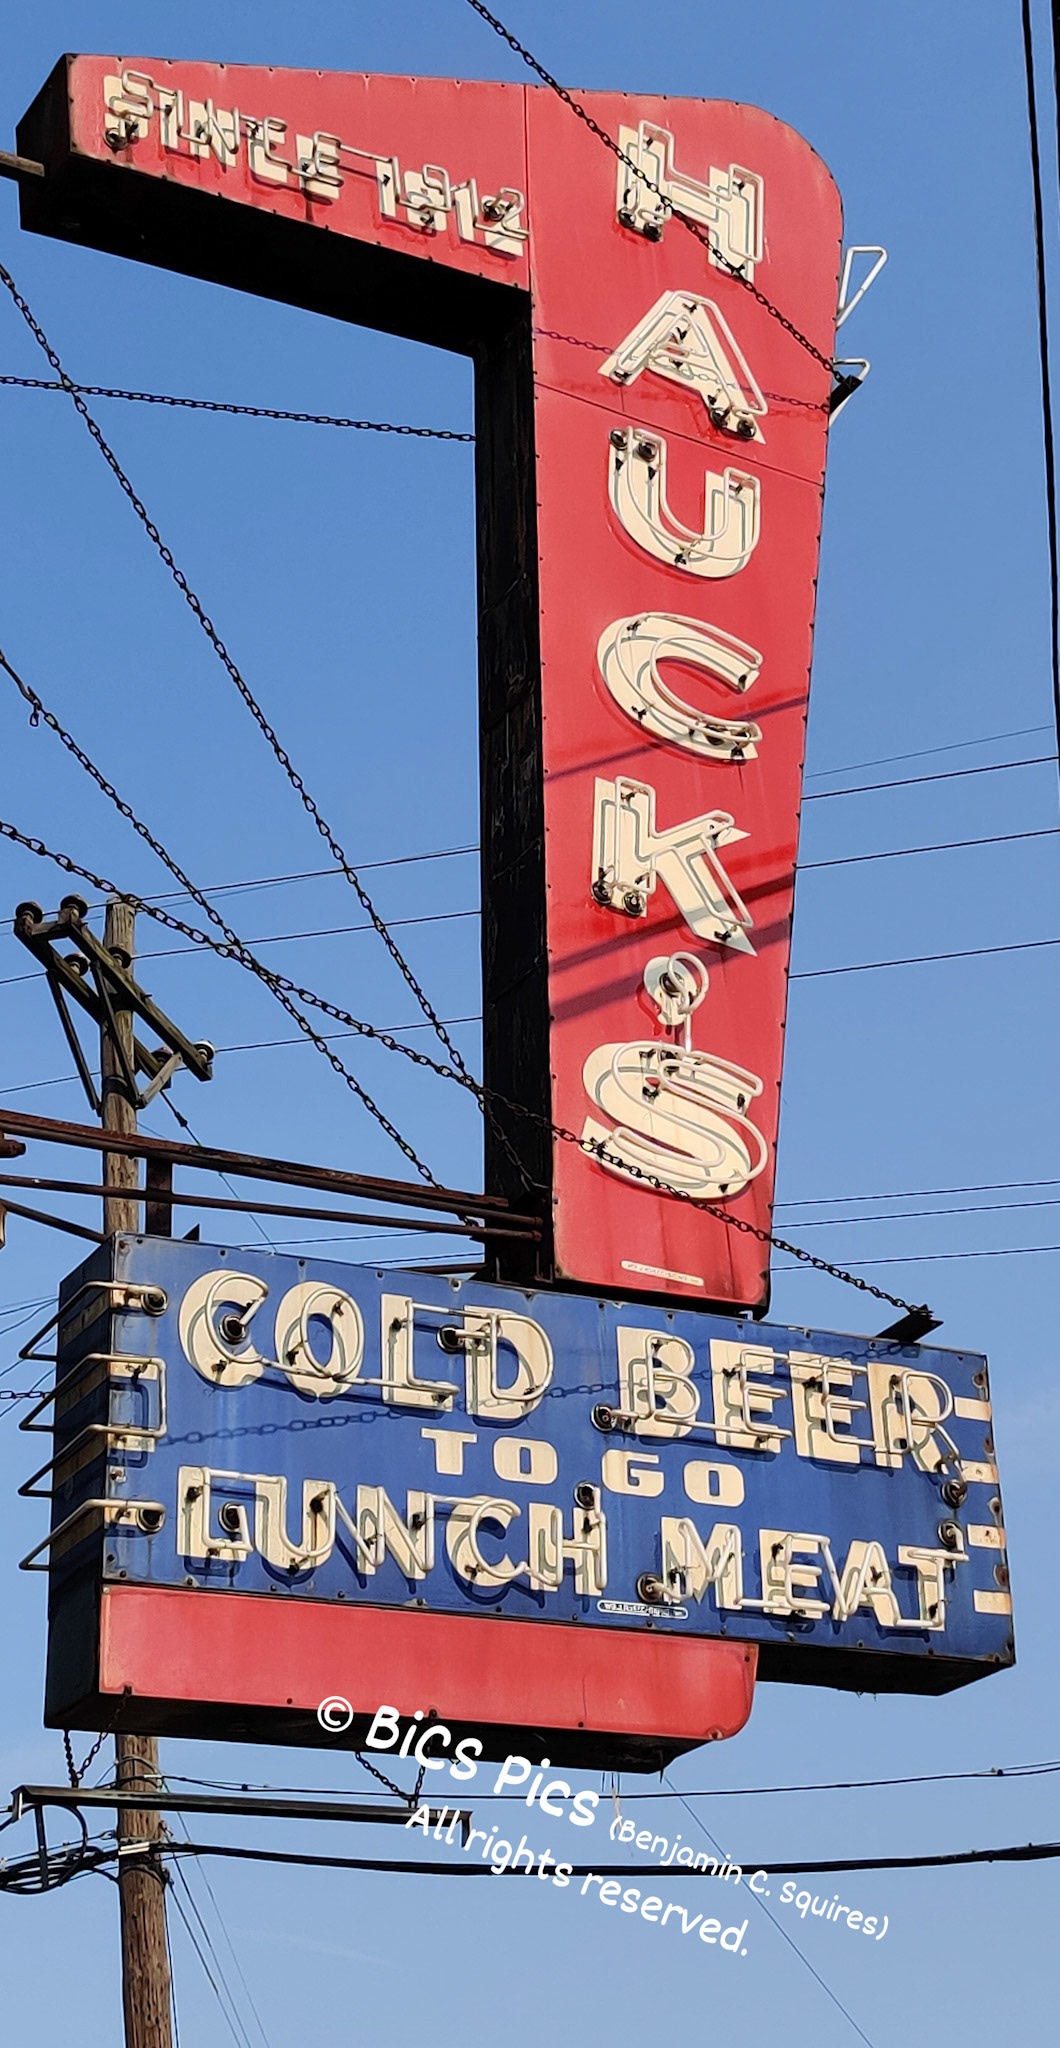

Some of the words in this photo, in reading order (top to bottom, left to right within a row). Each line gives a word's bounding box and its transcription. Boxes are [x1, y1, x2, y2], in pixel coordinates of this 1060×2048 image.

[103, 70, 343, 200] SINCE
[374, 155, 530, 257] 1912
[580, 119, 768, 1199] HAUCK'S
[178, 1269, 554, 1420] COLD
[616, 1326, 962, 1475] BEER
[176, 1465, 607, 1596] LUNCH
[660, 1516, 969, 1631] MEAT
[421, 1427, 558, 1485] TO
[601, 1449, 745, 1507] GO
